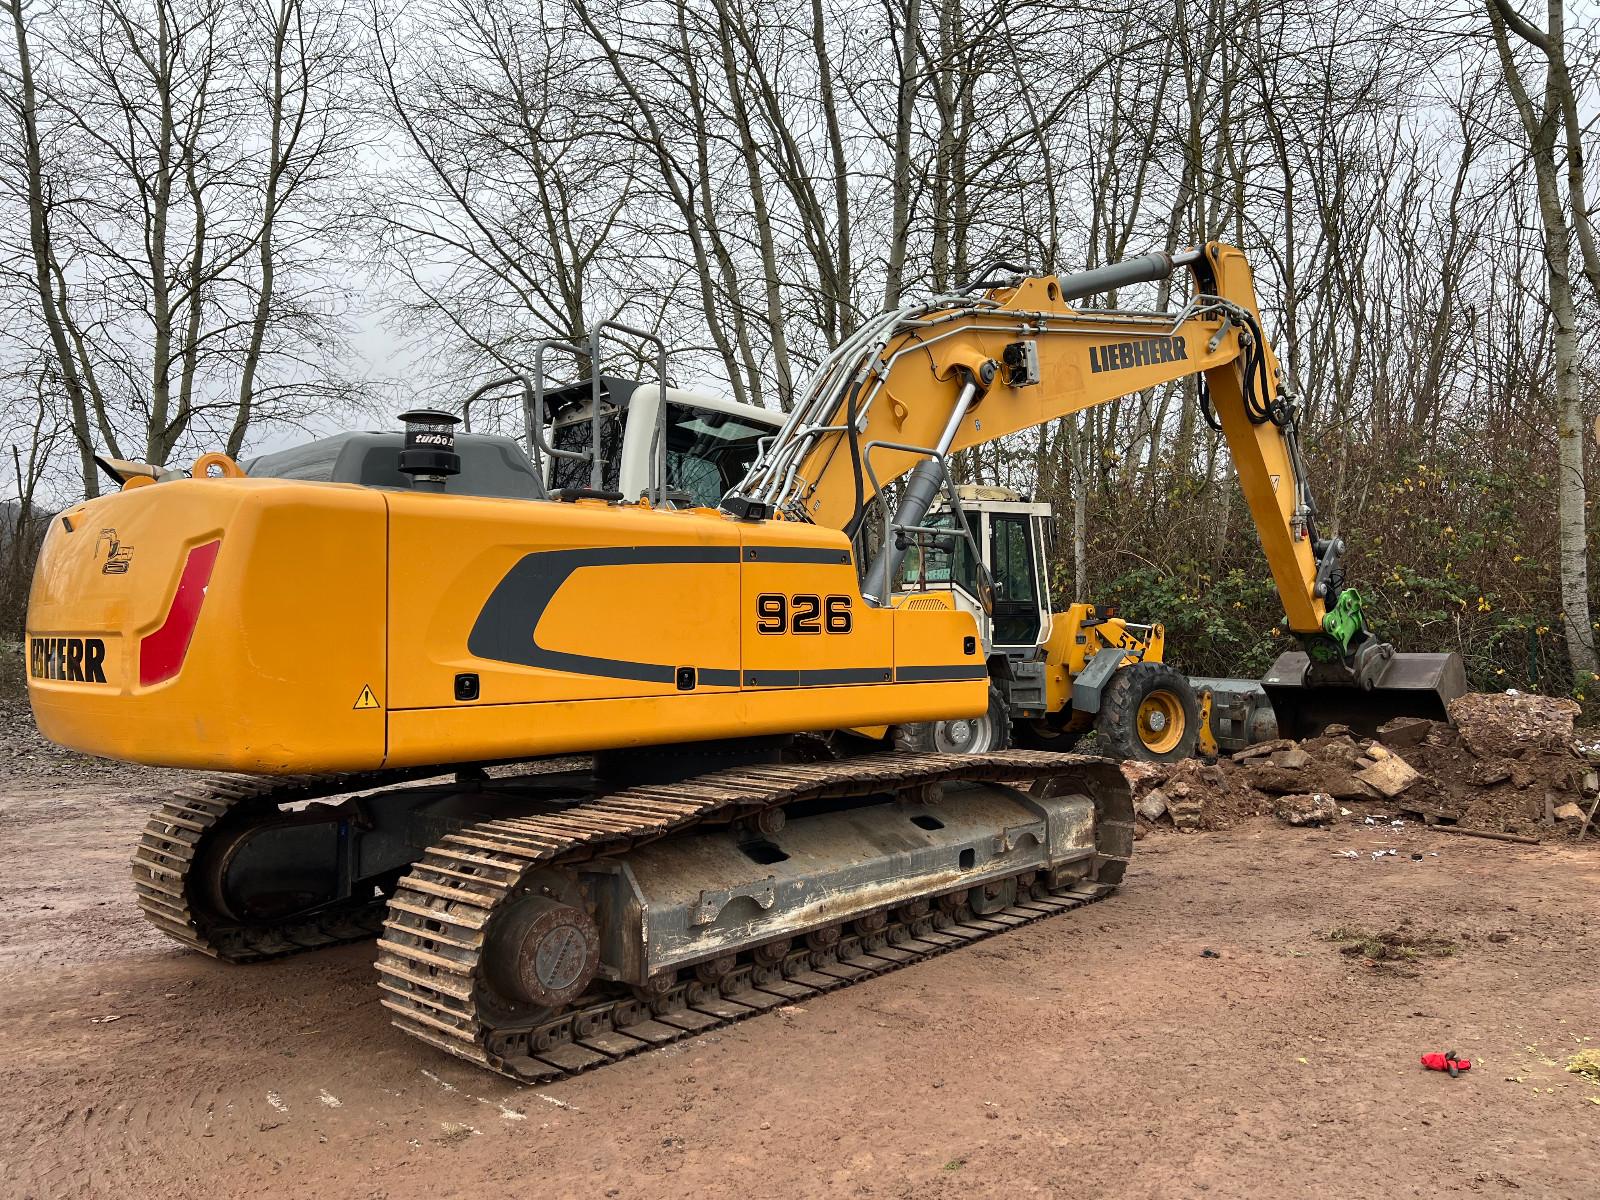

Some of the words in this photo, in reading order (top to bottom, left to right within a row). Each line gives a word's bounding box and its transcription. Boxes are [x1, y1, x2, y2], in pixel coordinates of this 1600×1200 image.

[1089, 336, 1188, 373] LIEBHERR
[415, 434, 448, 445] turbo
[756, 593, 852, 635] 926
